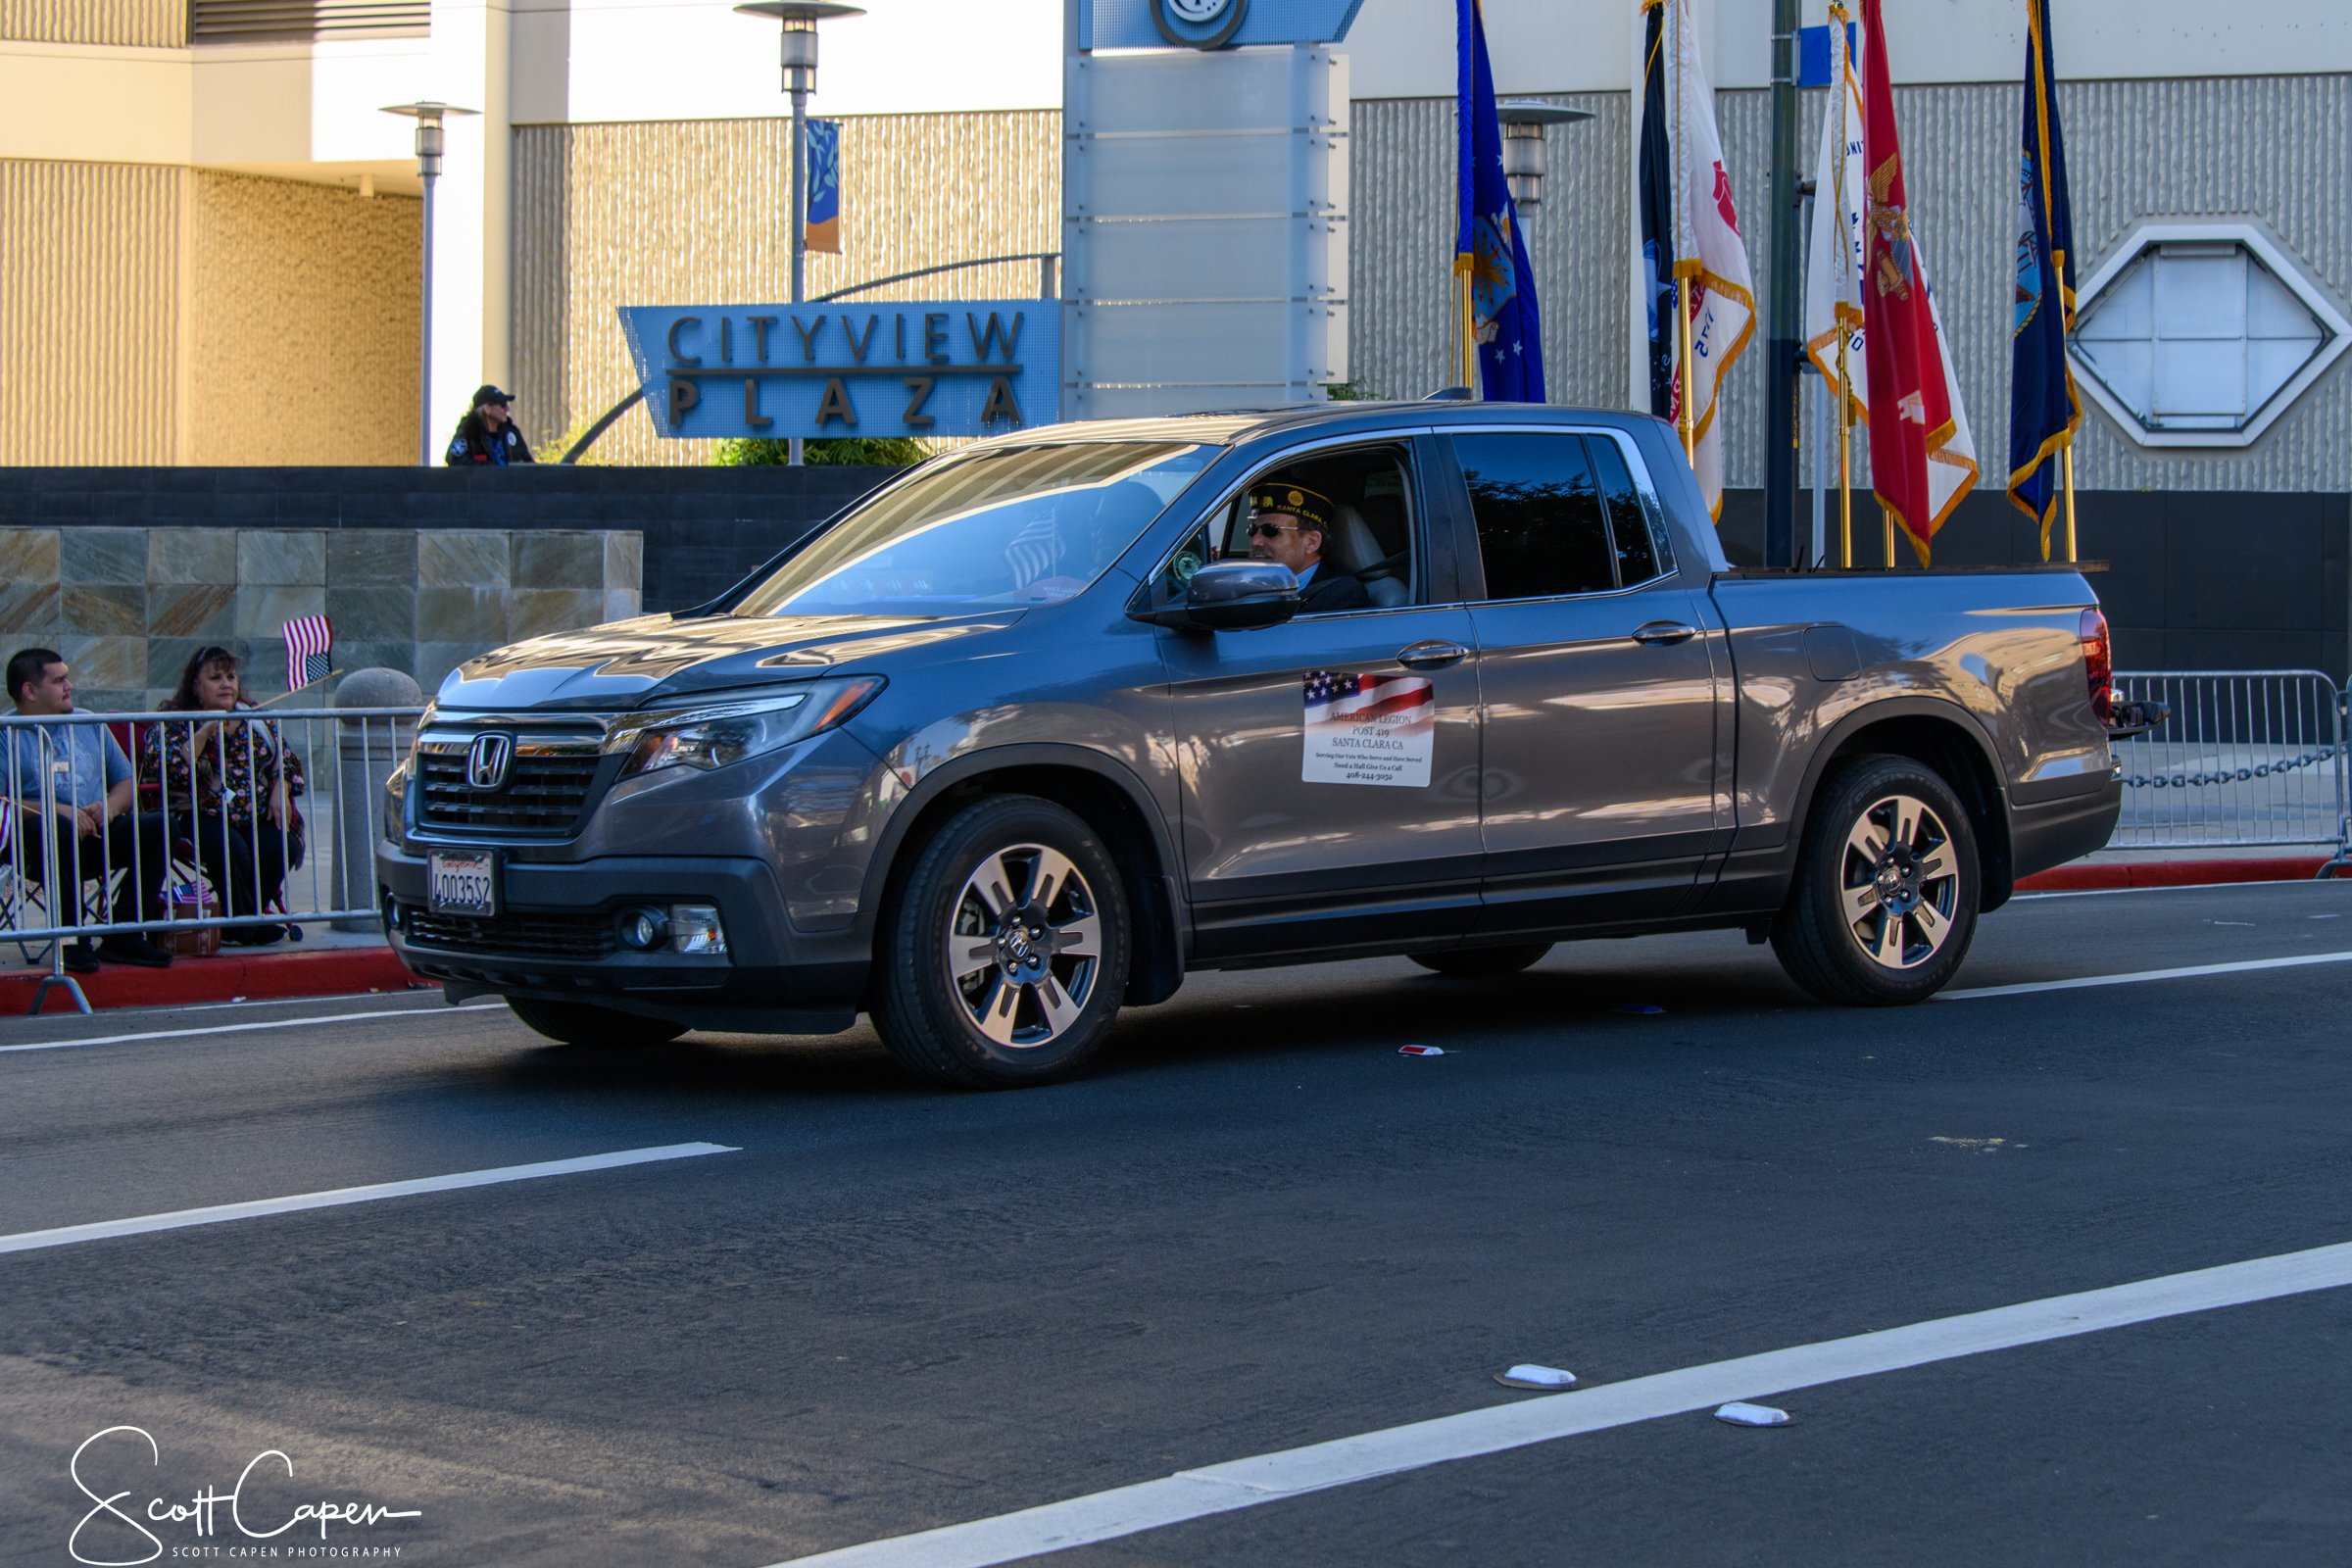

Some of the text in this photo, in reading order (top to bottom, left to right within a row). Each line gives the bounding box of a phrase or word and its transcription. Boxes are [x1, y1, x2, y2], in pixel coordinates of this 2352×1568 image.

[667, 311, 1023, 365] CITYVIEW
[669, 375, 1023, 426] PLAZA
[1329, 711, 1412, 725] AMERICAN LEGION
[1352, 725, 1390, 739] POST 419
[1332, 737, 1403, 750] SANTA CLARA CA
